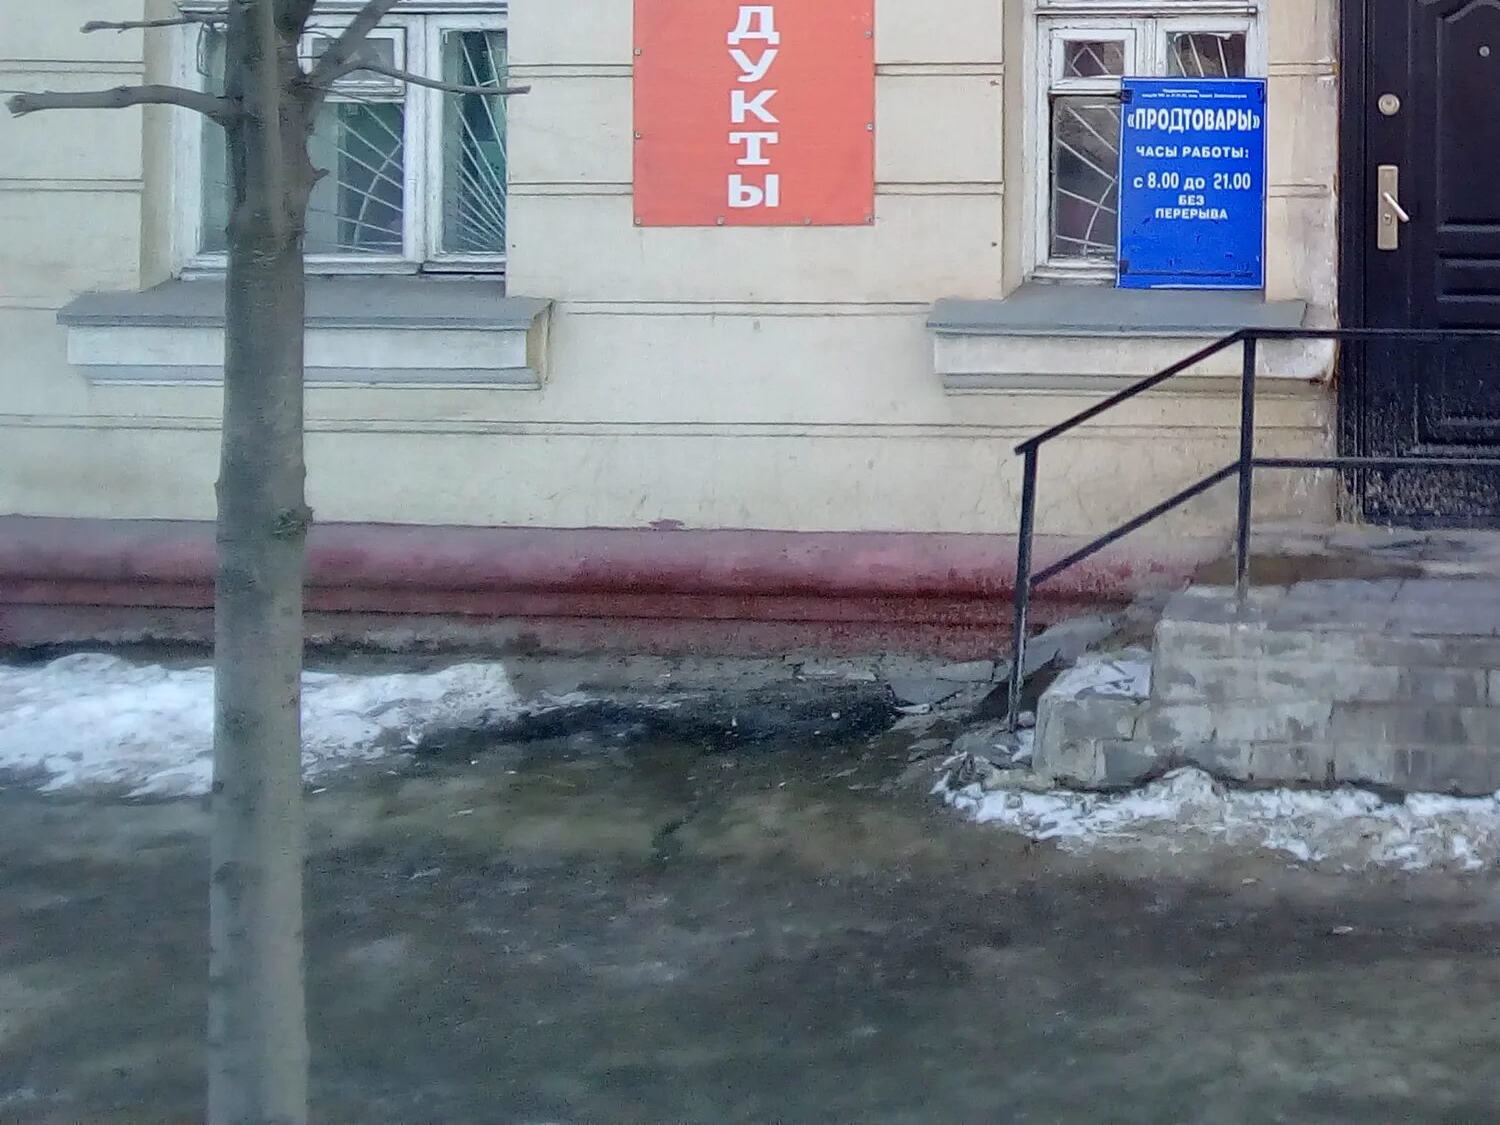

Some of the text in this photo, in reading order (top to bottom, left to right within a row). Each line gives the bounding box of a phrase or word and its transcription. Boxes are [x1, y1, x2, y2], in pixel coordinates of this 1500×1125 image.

[1127, 108, 1260, 134] «ПРОДТОВАРЫ»
[1136, 146, 1249, 158] ЧАСЫ РАБОТЫ:
[1147, 172, 1179, 189] 8.00
[1183, 177, 1205, 191] до
[1213, 173, 1251, 190] 21.00
[1178, 195, 1205, 206] БЕЗ
[1155, 208, 1228, 219] ПЕРЕРЫВА
